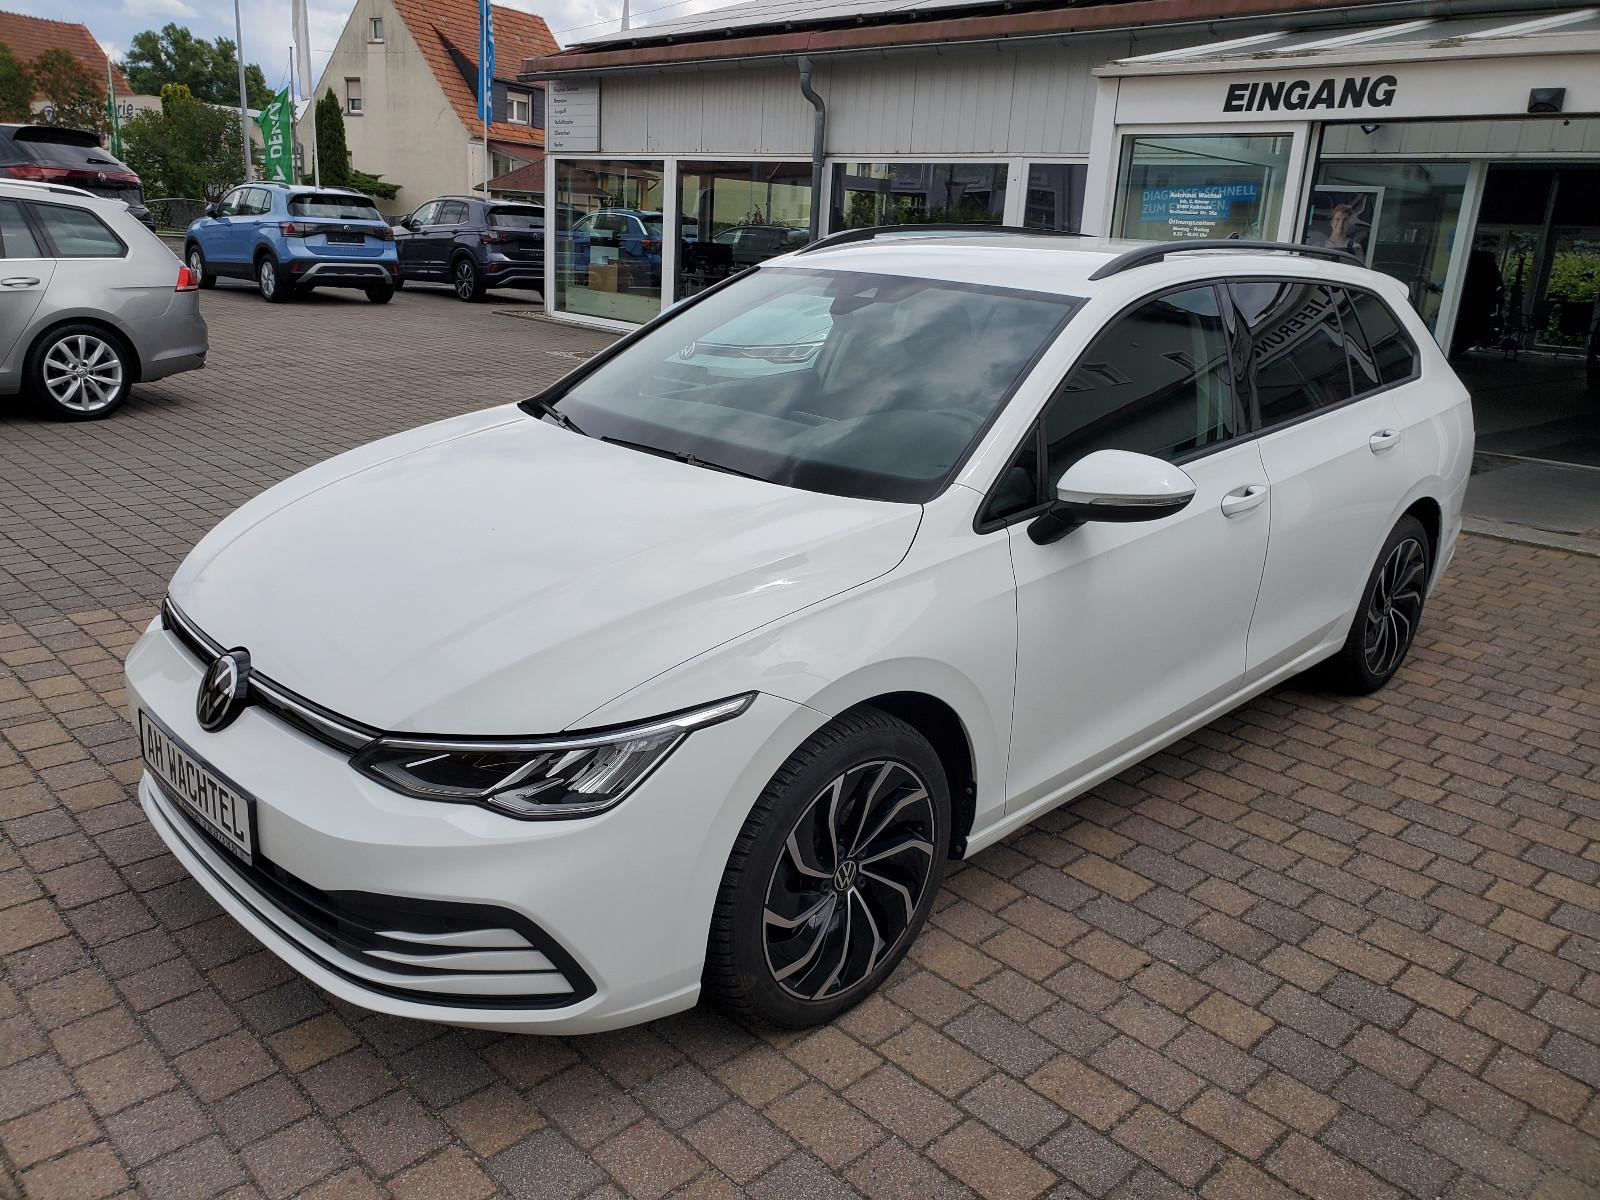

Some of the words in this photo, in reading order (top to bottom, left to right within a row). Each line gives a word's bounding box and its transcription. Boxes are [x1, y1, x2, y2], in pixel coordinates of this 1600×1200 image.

[1223, 75, 1398, 112] EINGANG
[1205, 184, 1256, 198] SCHNELL
[1142, 203, 1166, 214] ZUM
[147, 723, 164, 772] AH
[166, 742, 245, 843] WACHTEL
